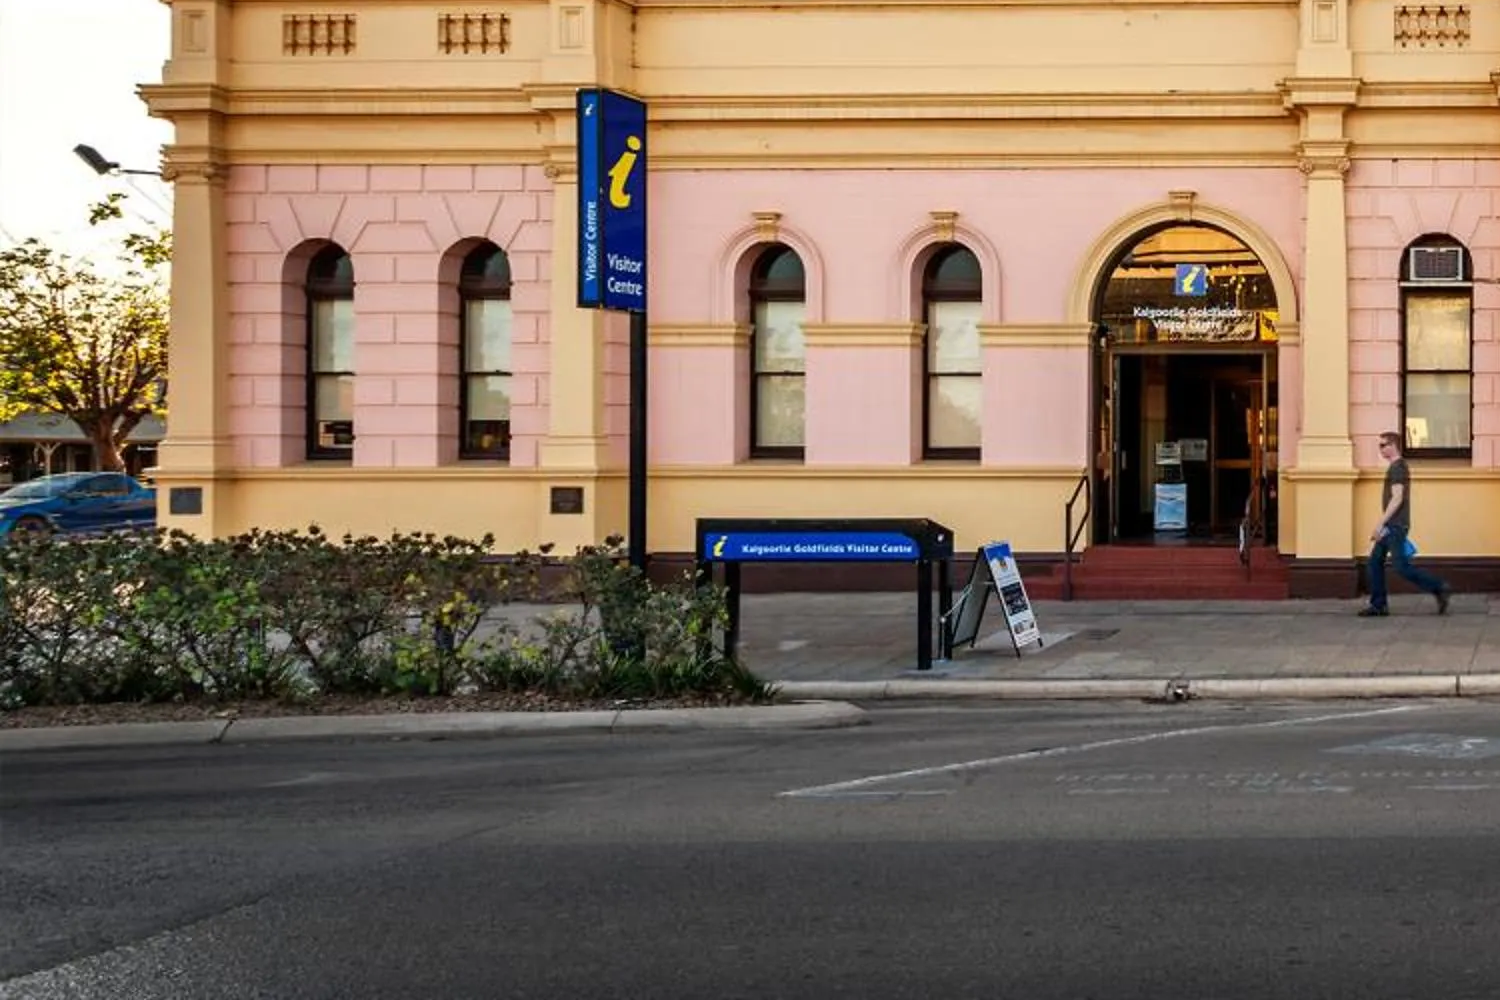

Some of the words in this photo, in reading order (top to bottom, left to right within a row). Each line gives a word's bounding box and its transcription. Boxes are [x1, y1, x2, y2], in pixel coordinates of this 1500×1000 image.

[584, 200, 597, 240] Centre
[584, 242, 597, 281] Visitor
[607, 252, 643, 274] Visitor
[607, 276, 643, 296] Centre
[742, 543, 792, 555] Kalgoorlie
[793, 543, 845, 553] Goldfields
[847, 543, 879, 553] Visitor
[881, 543, 913, 553] Centre
